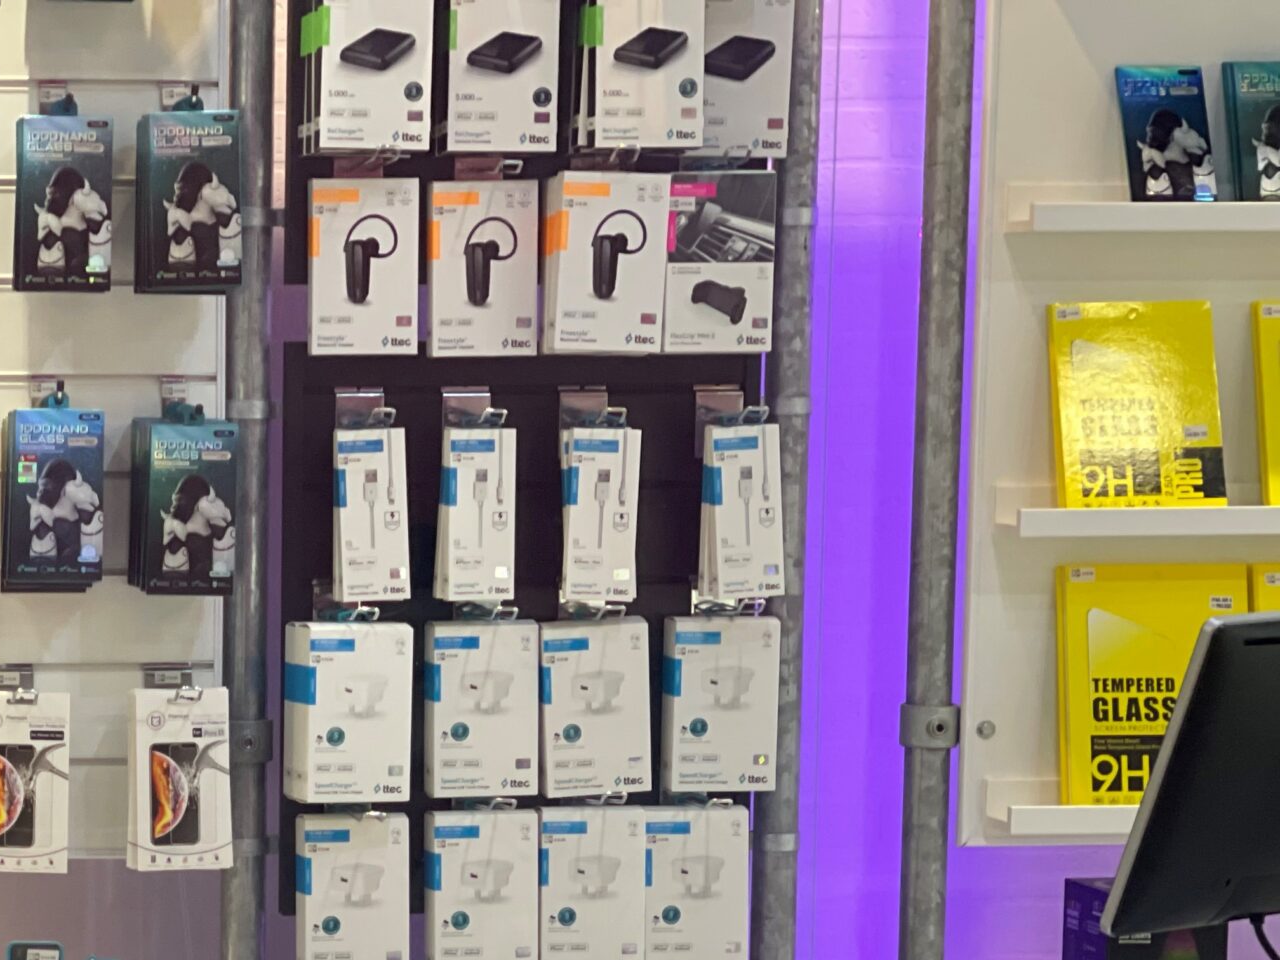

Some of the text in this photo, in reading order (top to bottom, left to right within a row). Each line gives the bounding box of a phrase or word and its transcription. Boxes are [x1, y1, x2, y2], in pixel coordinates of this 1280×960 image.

[19, 434, 65, 445] GLASS
[154, 449, 199, 460] GLASS
[1081, 465, 1135, 498] 9H
[1175, 458, 1205, 499] PRO
[1092, 677, 1175, 693] TEMPERED
[1092, 697, 1177, 722] GLASS
[1128, 724, 1166, 732] PROTECT
[1092, 753, 1150, 792] 9H
